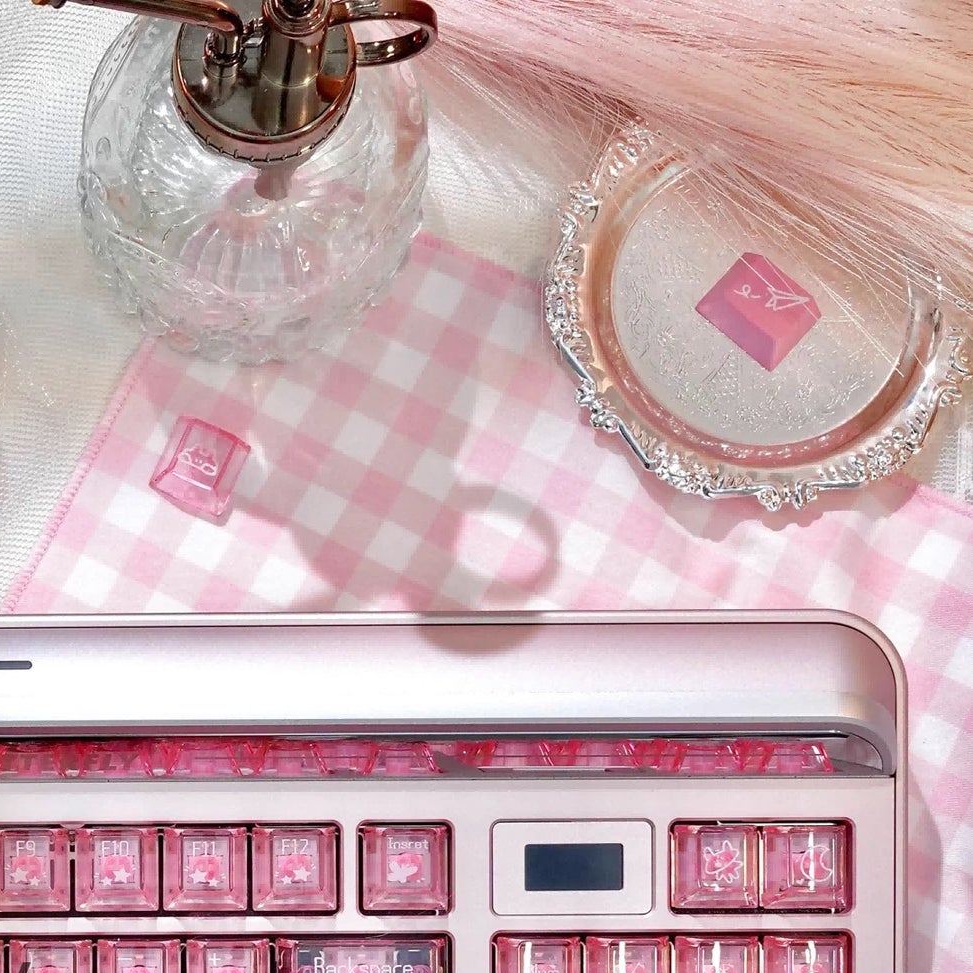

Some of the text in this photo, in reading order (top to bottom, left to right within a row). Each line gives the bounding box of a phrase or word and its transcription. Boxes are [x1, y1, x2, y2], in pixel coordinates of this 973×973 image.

[16, 841, 36, 857] F9
[101, 841, 129, 857] F10
[192, 841, 215, 856] F11
[281, 839, 309, 855] F12
